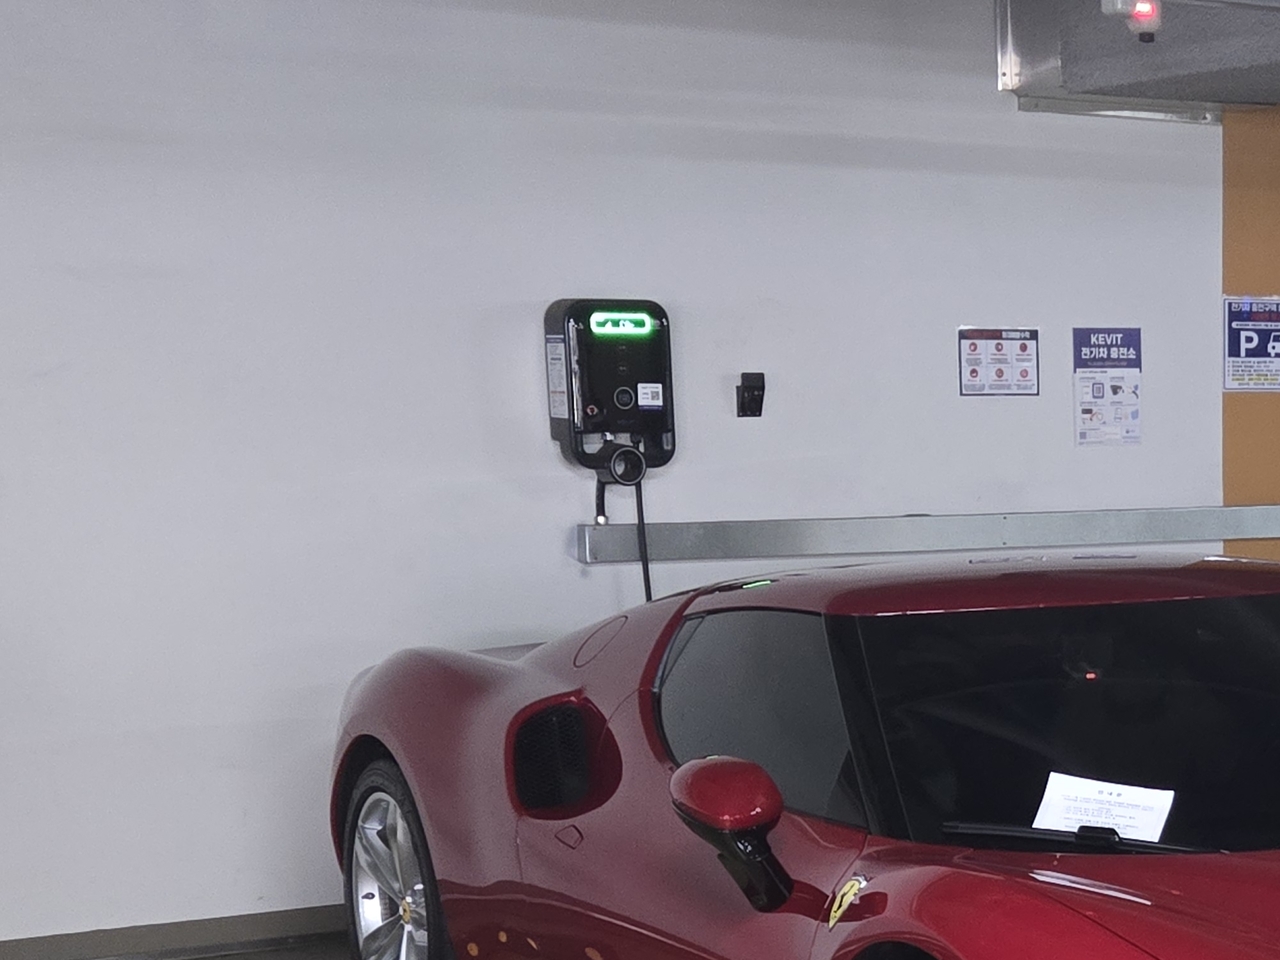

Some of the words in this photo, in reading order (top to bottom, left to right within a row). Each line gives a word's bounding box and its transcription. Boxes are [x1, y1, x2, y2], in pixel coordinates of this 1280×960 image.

[1090, 333, 1124, 345] KEVIT
[1240, 330, 1259, 358] P
[1081, 346, 1108, 359] 전기차
[1110, 346, 1137, 359] 충전소
